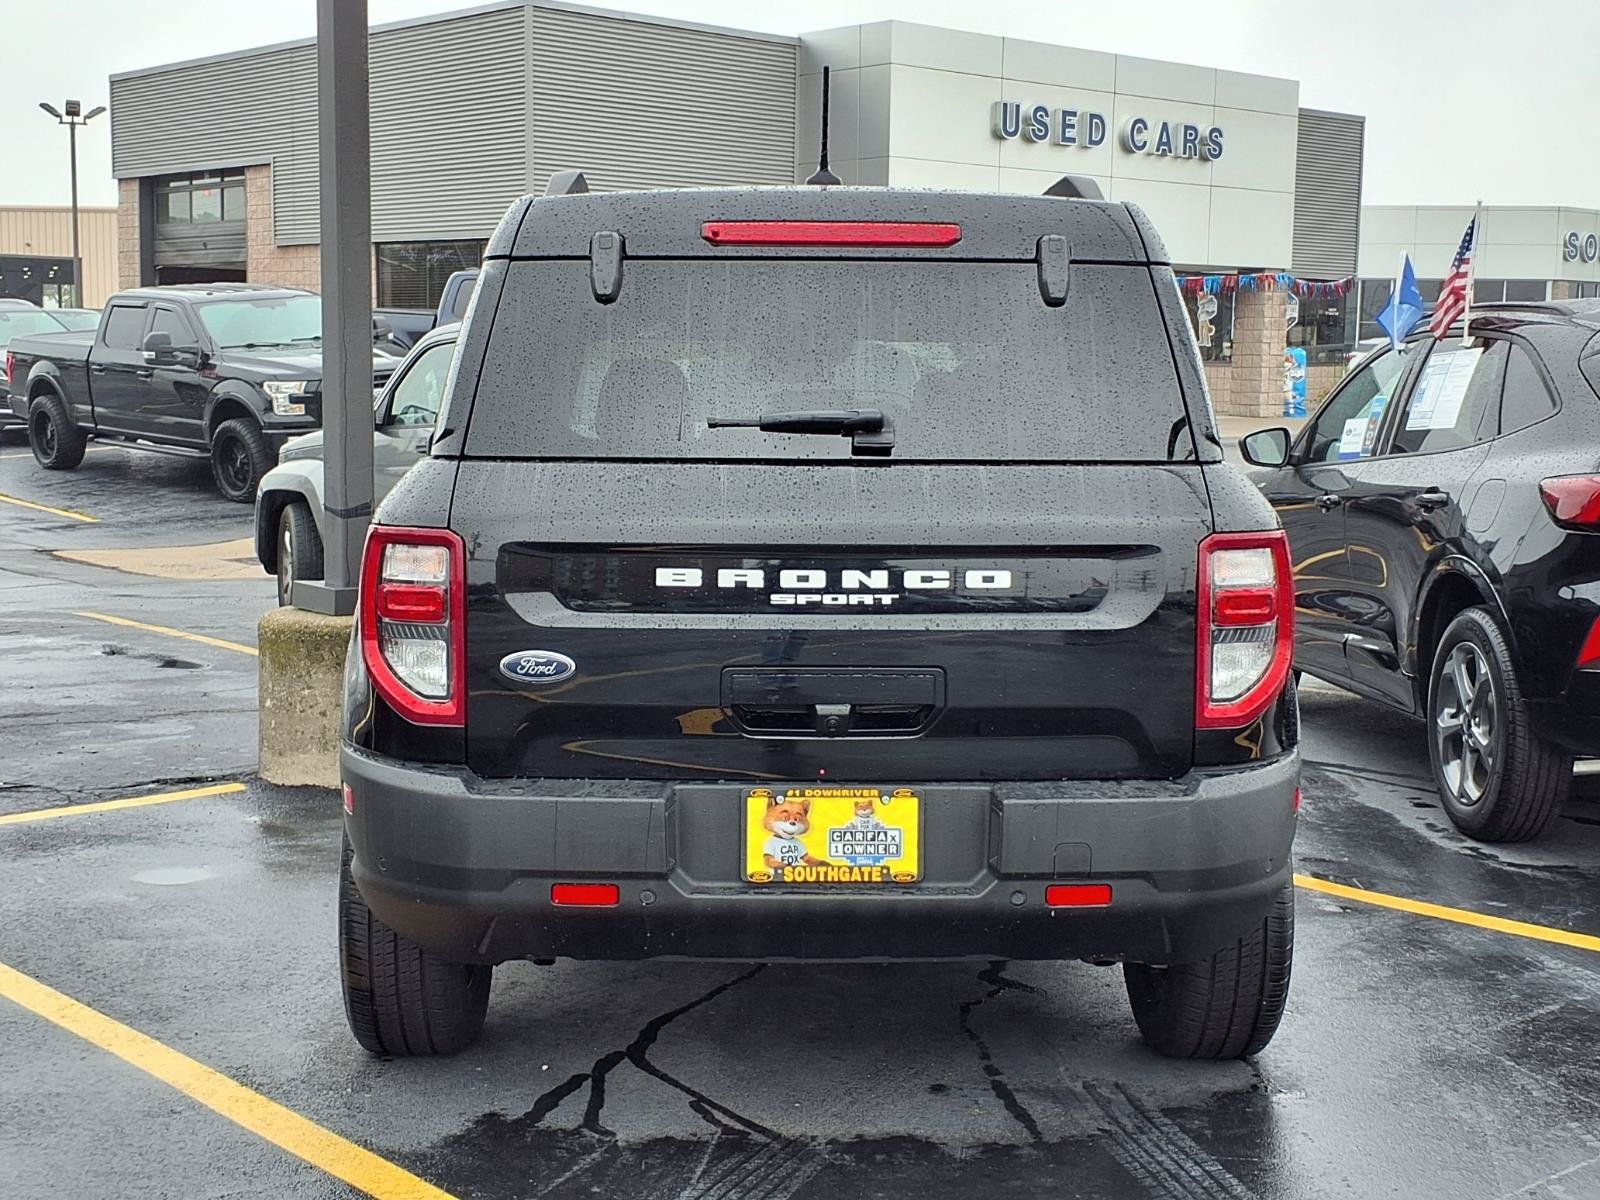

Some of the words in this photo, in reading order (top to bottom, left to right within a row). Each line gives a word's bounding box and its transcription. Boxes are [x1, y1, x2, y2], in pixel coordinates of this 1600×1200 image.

[997, 101, 1107, 147] USED
[1126, 117, 1224, 161] CARS
[1564, 231, 1600, 264] SO
[655, 567, 1012, 589] BRONCO
[770, 593, 900, 606] SPORT
[517, 657, 557, 675] Ford
[804, 789, 879, 797] DOWNRIVER
[832, 831, 897, 843] CARFAX
[780, 845, 799, 854] CAR
[781, 855, 800, 864] FOX
[783, 866, 882, 882] SOUTHGATE
